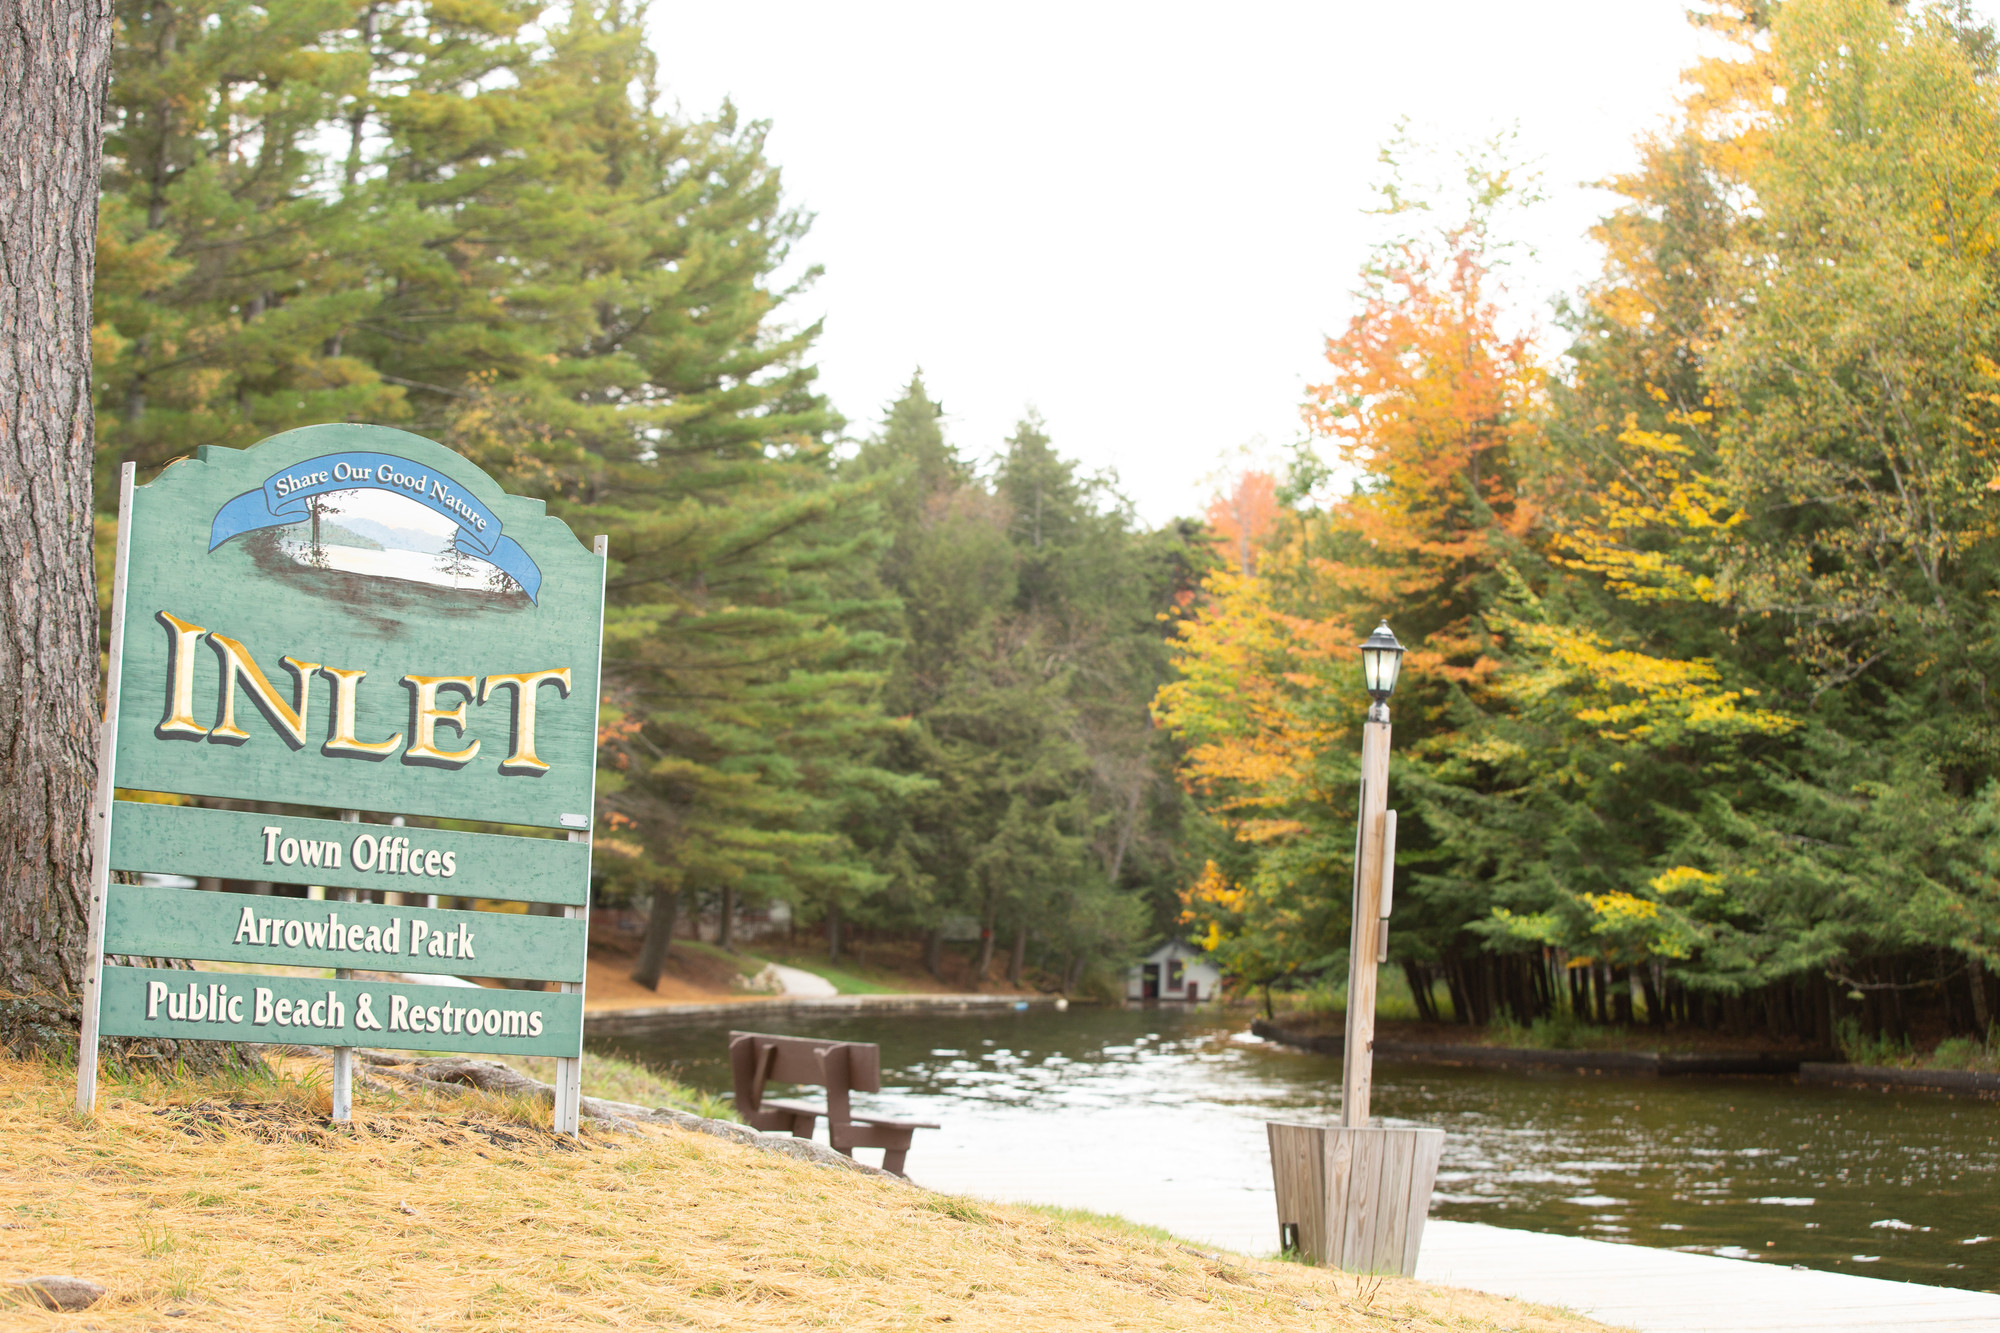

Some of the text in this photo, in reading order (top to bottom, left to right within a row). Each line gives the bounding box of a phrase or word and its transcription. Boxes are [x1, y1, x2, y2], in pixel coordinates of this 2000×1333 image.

[275, 462, 488, 532] Share Our Good Nature
[154, 609, 571, 778] INLET
[262, 826, 457, 878] Town Offices
[233, 906, 476, 960] Arrowhead Park
[146, 981, 544, 1038] Public Beach & Restrooms
